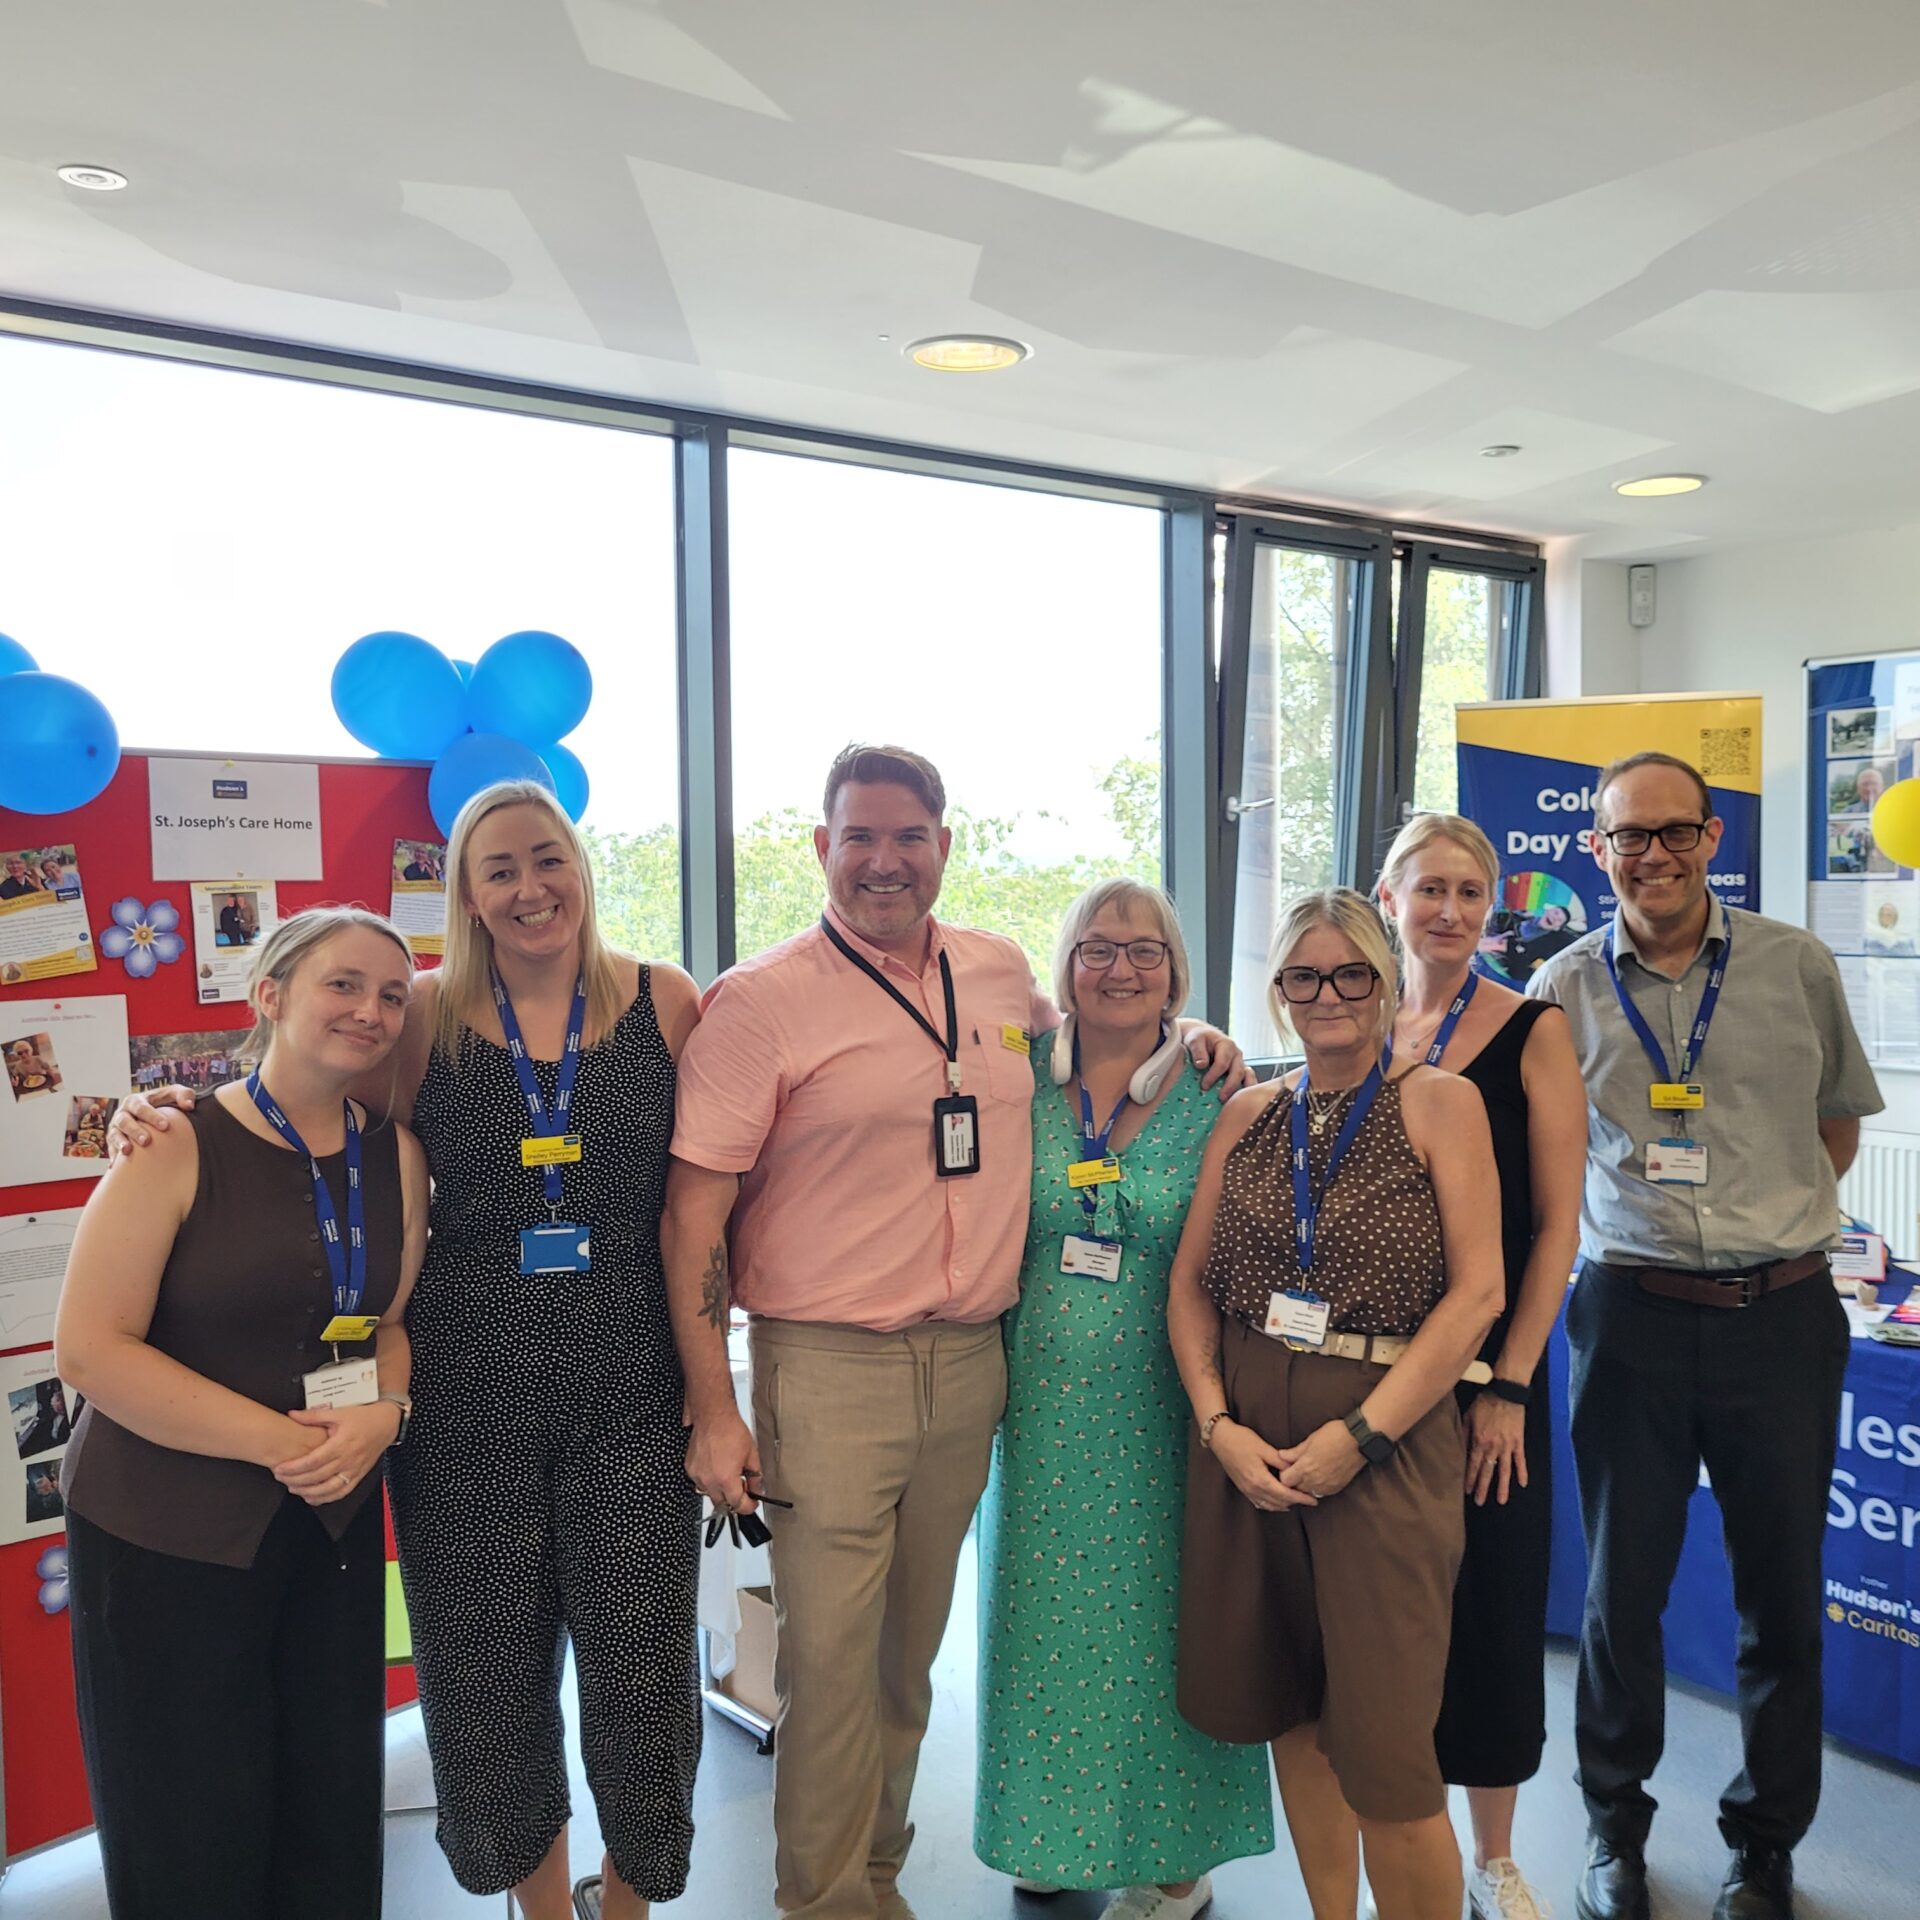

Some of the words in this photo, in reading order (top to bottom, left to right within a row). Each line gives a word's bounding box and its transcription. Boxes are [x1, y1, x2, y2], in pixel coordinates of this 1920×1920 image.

[155, 815, 174, 828] St.
[178, 816, 235, 831] Joseph's
[239, 817, 270, 829] Care
[273, 818, 313, 830] Home
[1507, 831, 1571, 862] Day
[1839, 1390, 1920, 1468] les
[1826, 1468, 1920, 1549] Ser
[1826, 1579, 1920, 1625] Hudson's
[1847, 1609, 1920, 1648] Caritas
